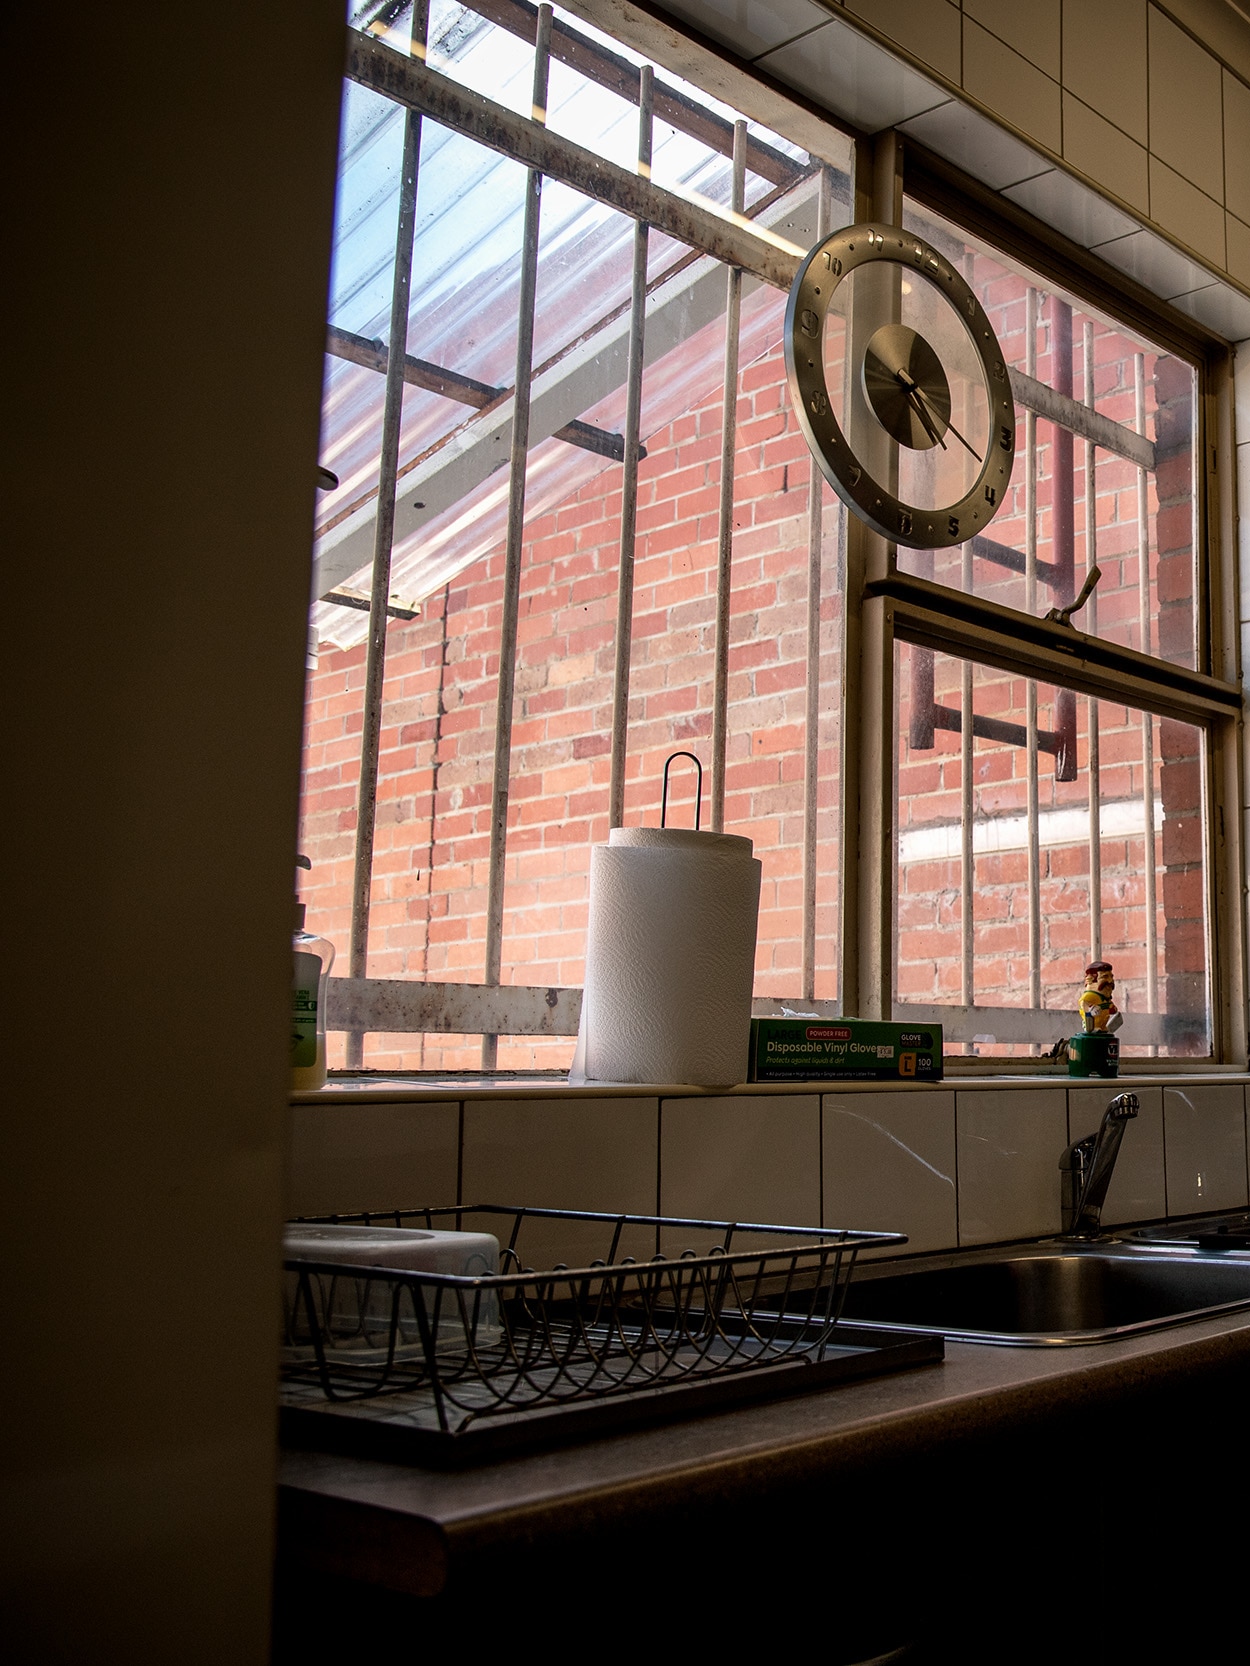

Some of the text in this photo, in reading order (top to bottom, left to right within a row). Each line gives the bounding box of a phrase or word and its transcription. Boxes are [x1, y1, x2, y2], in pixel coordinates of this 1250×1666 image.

[999, 426, 1013, 451] 3
[767, 1029, 802, 1040] LARGE
[767, 1041, 822, 1054] Disposable
[824, 1042, 847, 1055] Vinyl
[849, 1043, 877, 1053] Glove
[766, 1056, 790, 1064] Protects
[791, 1057, 811, 1065] against
[918, 1058, 931, 1066] 100
[904, 1061, 911, 1072] L
